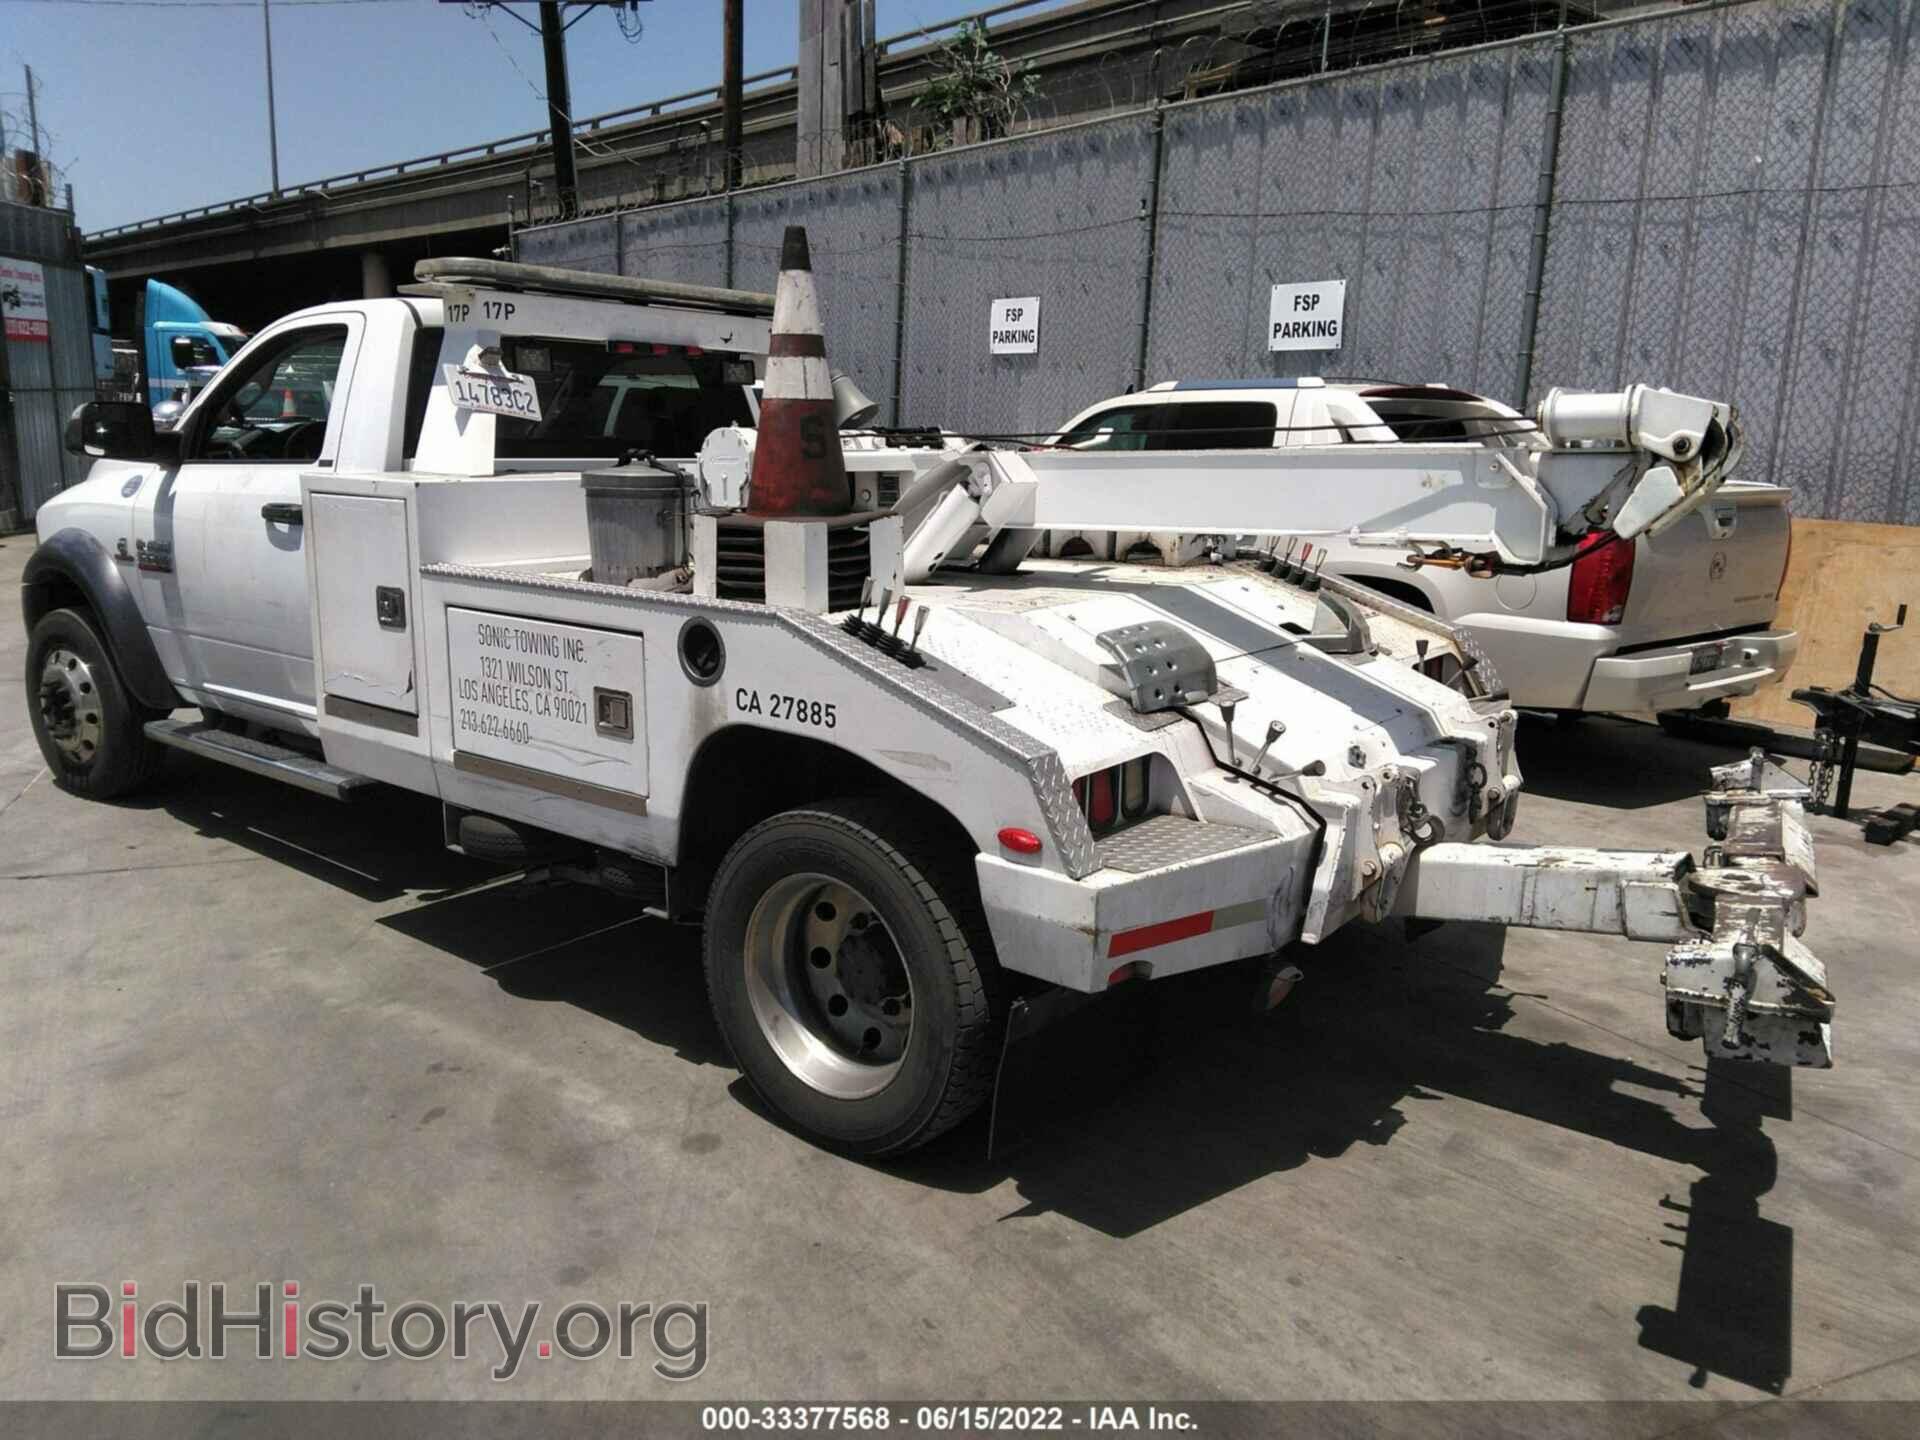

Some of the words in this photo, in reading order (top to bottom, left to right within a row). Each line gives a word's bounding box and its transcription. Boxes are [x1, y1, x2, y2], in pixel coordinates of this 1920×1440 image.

[484, 301, 516, 320] 17P
[1294, 294, 1320, 312] FSP
[448, 304, 470, 322] 17P
[1006, 308, 1024, 322] FSP
[992, 330, 1035, 344] PARKING
[1273, 320, 1338, 339] PARKING
[456, 381, 536, 414] 14783C2
[478, 623, 511, 650] SONIC
[513, 629, 560, 659] TOWING
[563, 637, 588, 663] INC.
[480, 656, 503, 681] 1321
[506, 661, 552, 690] WILSON
[555, 669, 573, 694] ST.
[458, 677, 478, 702] LOS
[481, 682, 533, 715] ANGELES,
[535, 692, 551, 717] CA
[554, 696, 587, 725] 90021
[736, 688, 762, 714] CA
[770, 694, 837, 728] 27885
